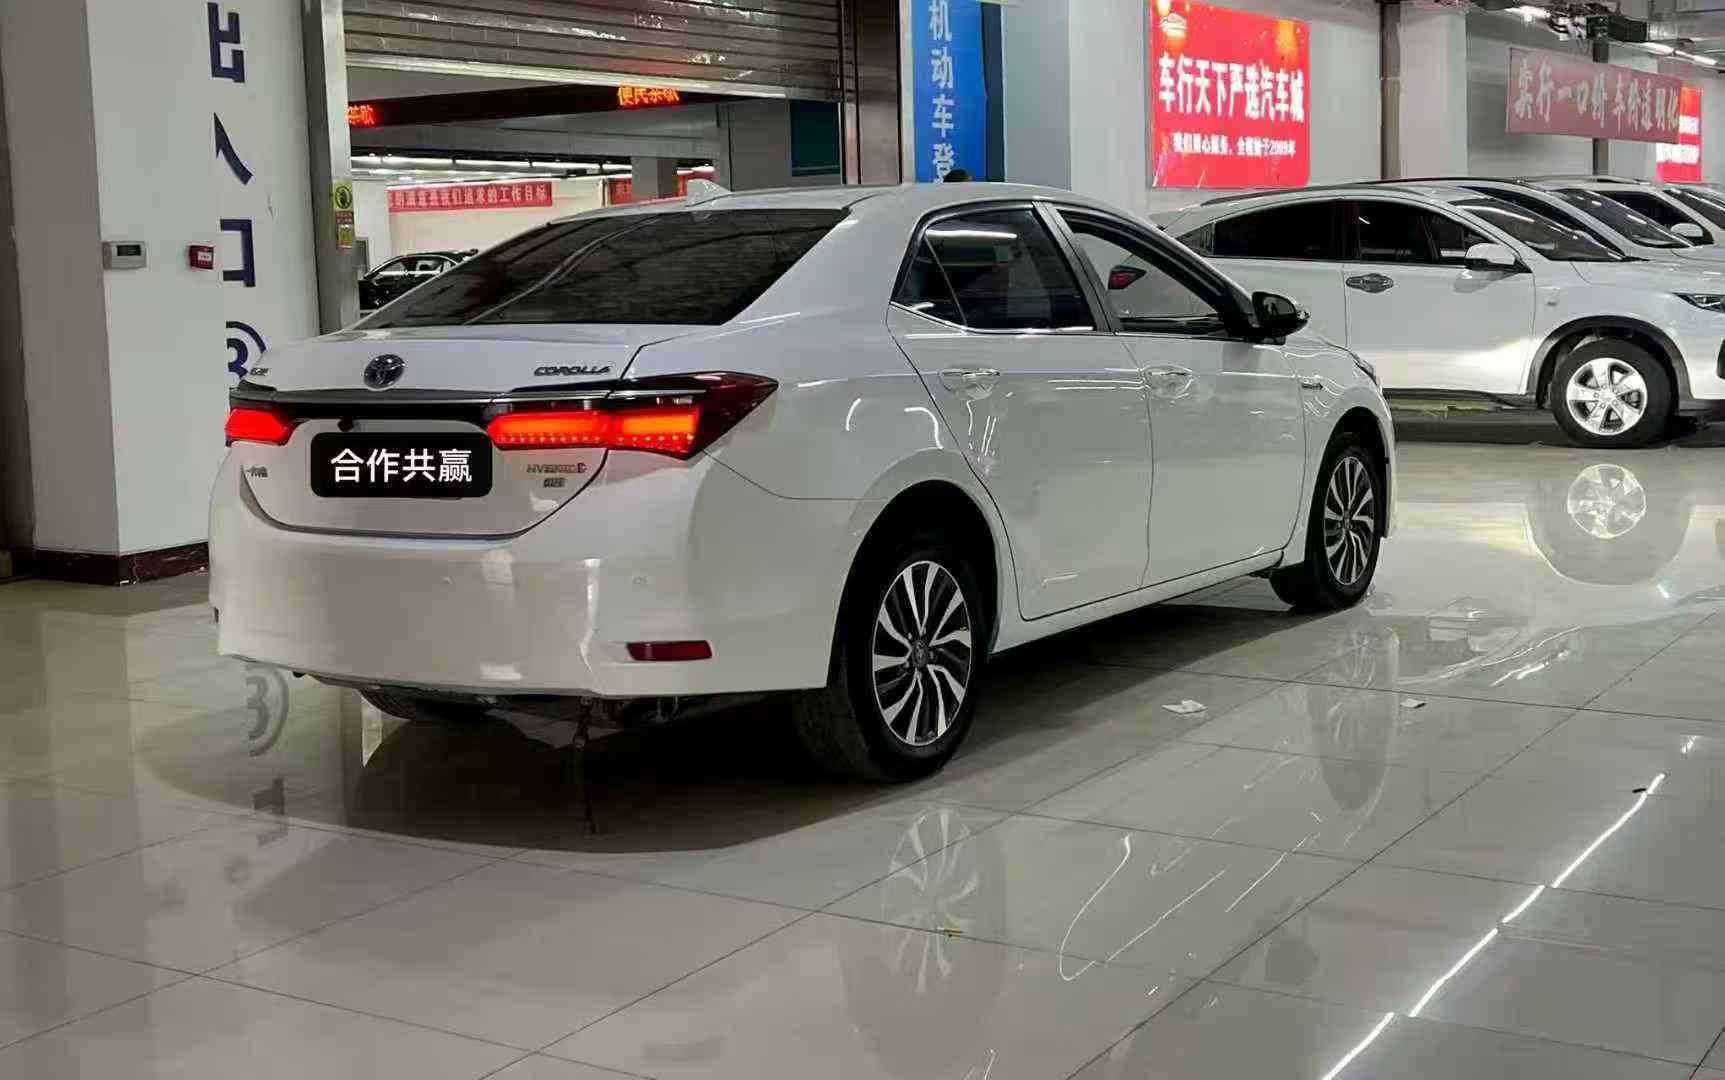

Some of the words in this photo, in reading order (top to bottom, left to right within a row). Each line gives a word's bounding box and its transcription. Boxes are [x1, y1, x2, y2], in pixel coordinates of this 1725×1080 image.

[1159, 52, 1304, 123] 车行天下严选汽车城
[534, 365, 612, 376] COROLLA
